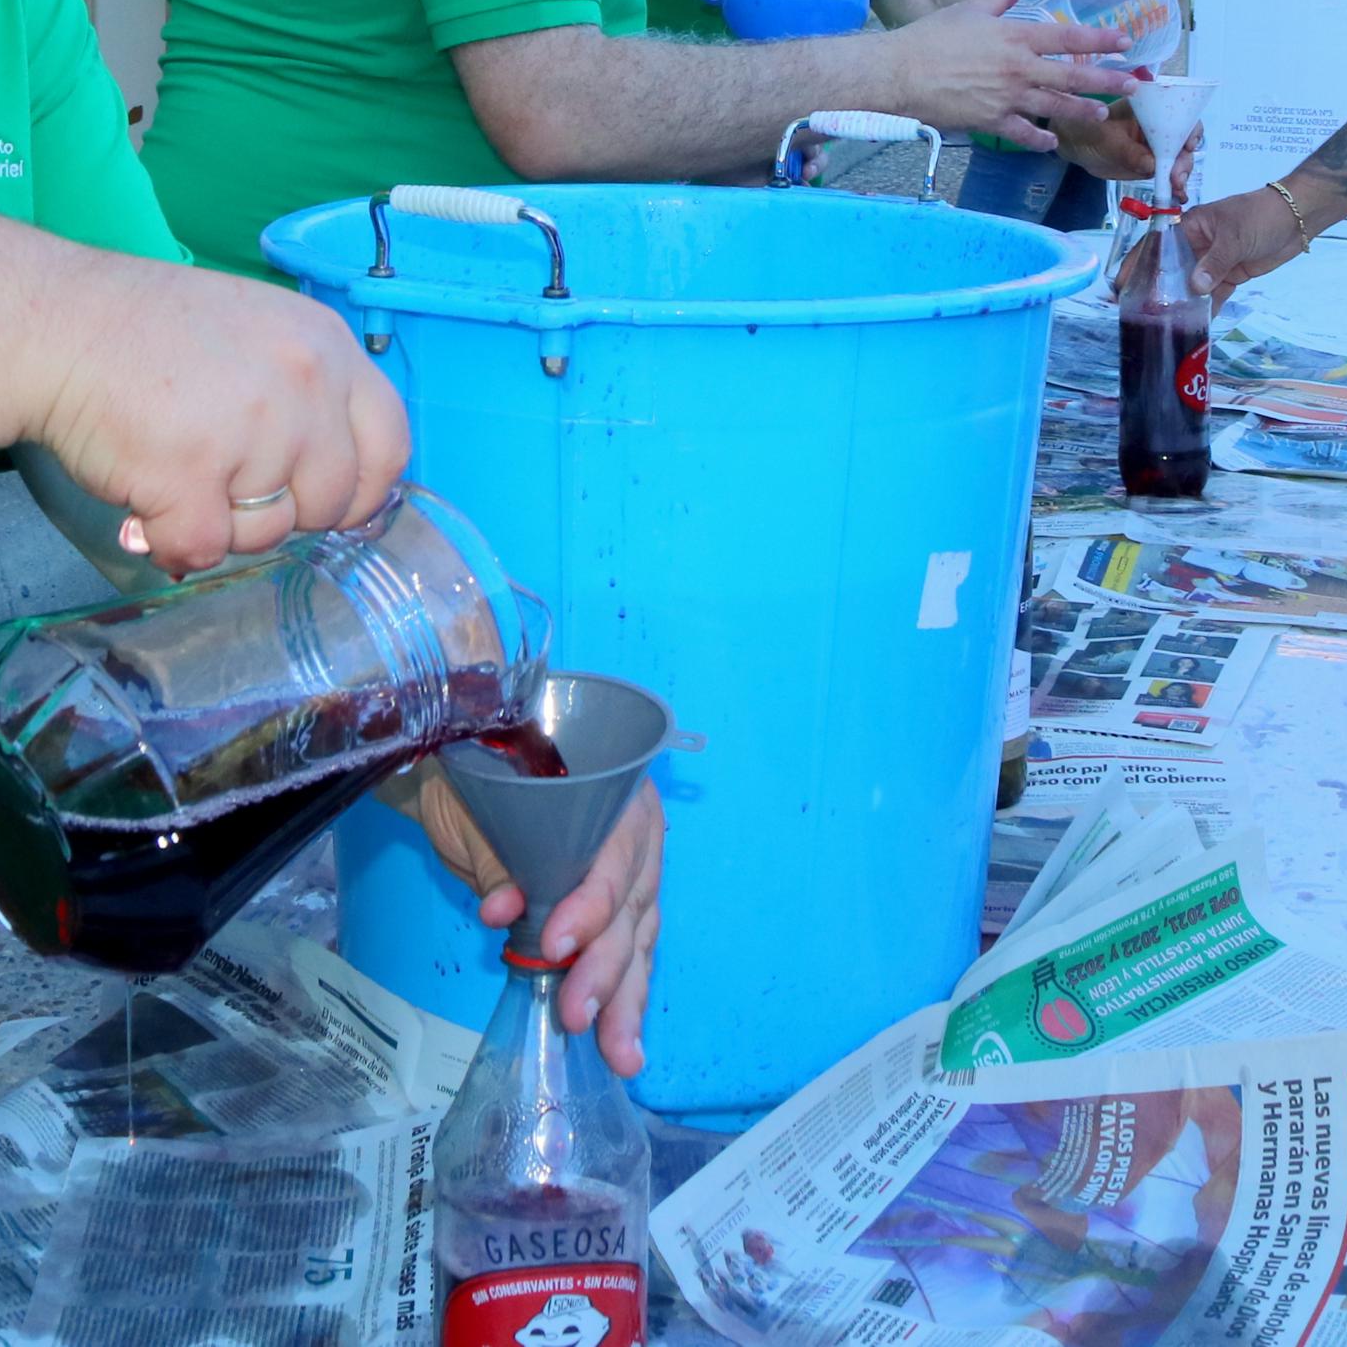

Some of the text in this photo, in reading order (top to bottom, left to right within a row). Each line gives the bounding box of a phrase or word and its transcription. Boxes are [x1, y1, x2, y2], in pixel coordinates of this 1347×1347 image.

[1124, 774, 1140, 784] el
[1143, 774, 1227, 785] Gobierno
[1165, 888, 1191, 909] libres
[1189, 874, 1218, 896] Plazas
[1207, 885, 1242, 914] OPE
[1092, 914, 1140, 945] Promoción
[1119, 925, 1162, 957] 2022
[1203, 923, 1262, 965] AUXILIAR
[1057, 936, 1093, 960] interna
[1086, 912, 1246, 1004] JUNTA de CASTILLA y LEÓN
[1105, 943, 1121, 961] y
[1223, 936, 1278, 976] CURSO
[1063, 952, 1106, 988] 2023
[1093, 951, 1206, 1018] ADMINISTRATIVO
[1123, 964, 1225, 1027] PRESENCIAL
[887, 1114, 899, 1125] de
[894, 1095, 917, 1118] cambio
[936, 1099, 950, 1110] La
[411, 1123, 429, 1136] la
[862, 1122, 892, 1150] cigarrillos
[405, 1135, 430, 1177] Franja
[1074, 1101, 1117, 1206] TAYLOR SWIFT
[1098, 1101, 1136, 1206] A LOS PIES DE
[1204, 1081, 1282, 1320] y Hermanas Hospitalarias
[1226, 1079, 1309, 1338] pararán en San Juan de Dios
[1252, 1077, 1332, 1347] Las nuevas líneas de autobú
[403, 1220, 423, 1252] siete
[484, 1225, 626, 1264] GASEOSA
[303, 1248, 354, 1287] 75
[398, 1253, 416, 1295] meses
[472, 1286, 489, 1305] SIN
[490, 1276, 574, 1299] CONSERVANTES
[583, 1275, 602, 1289] SIN
[396, 1301, 420, 1331] más
